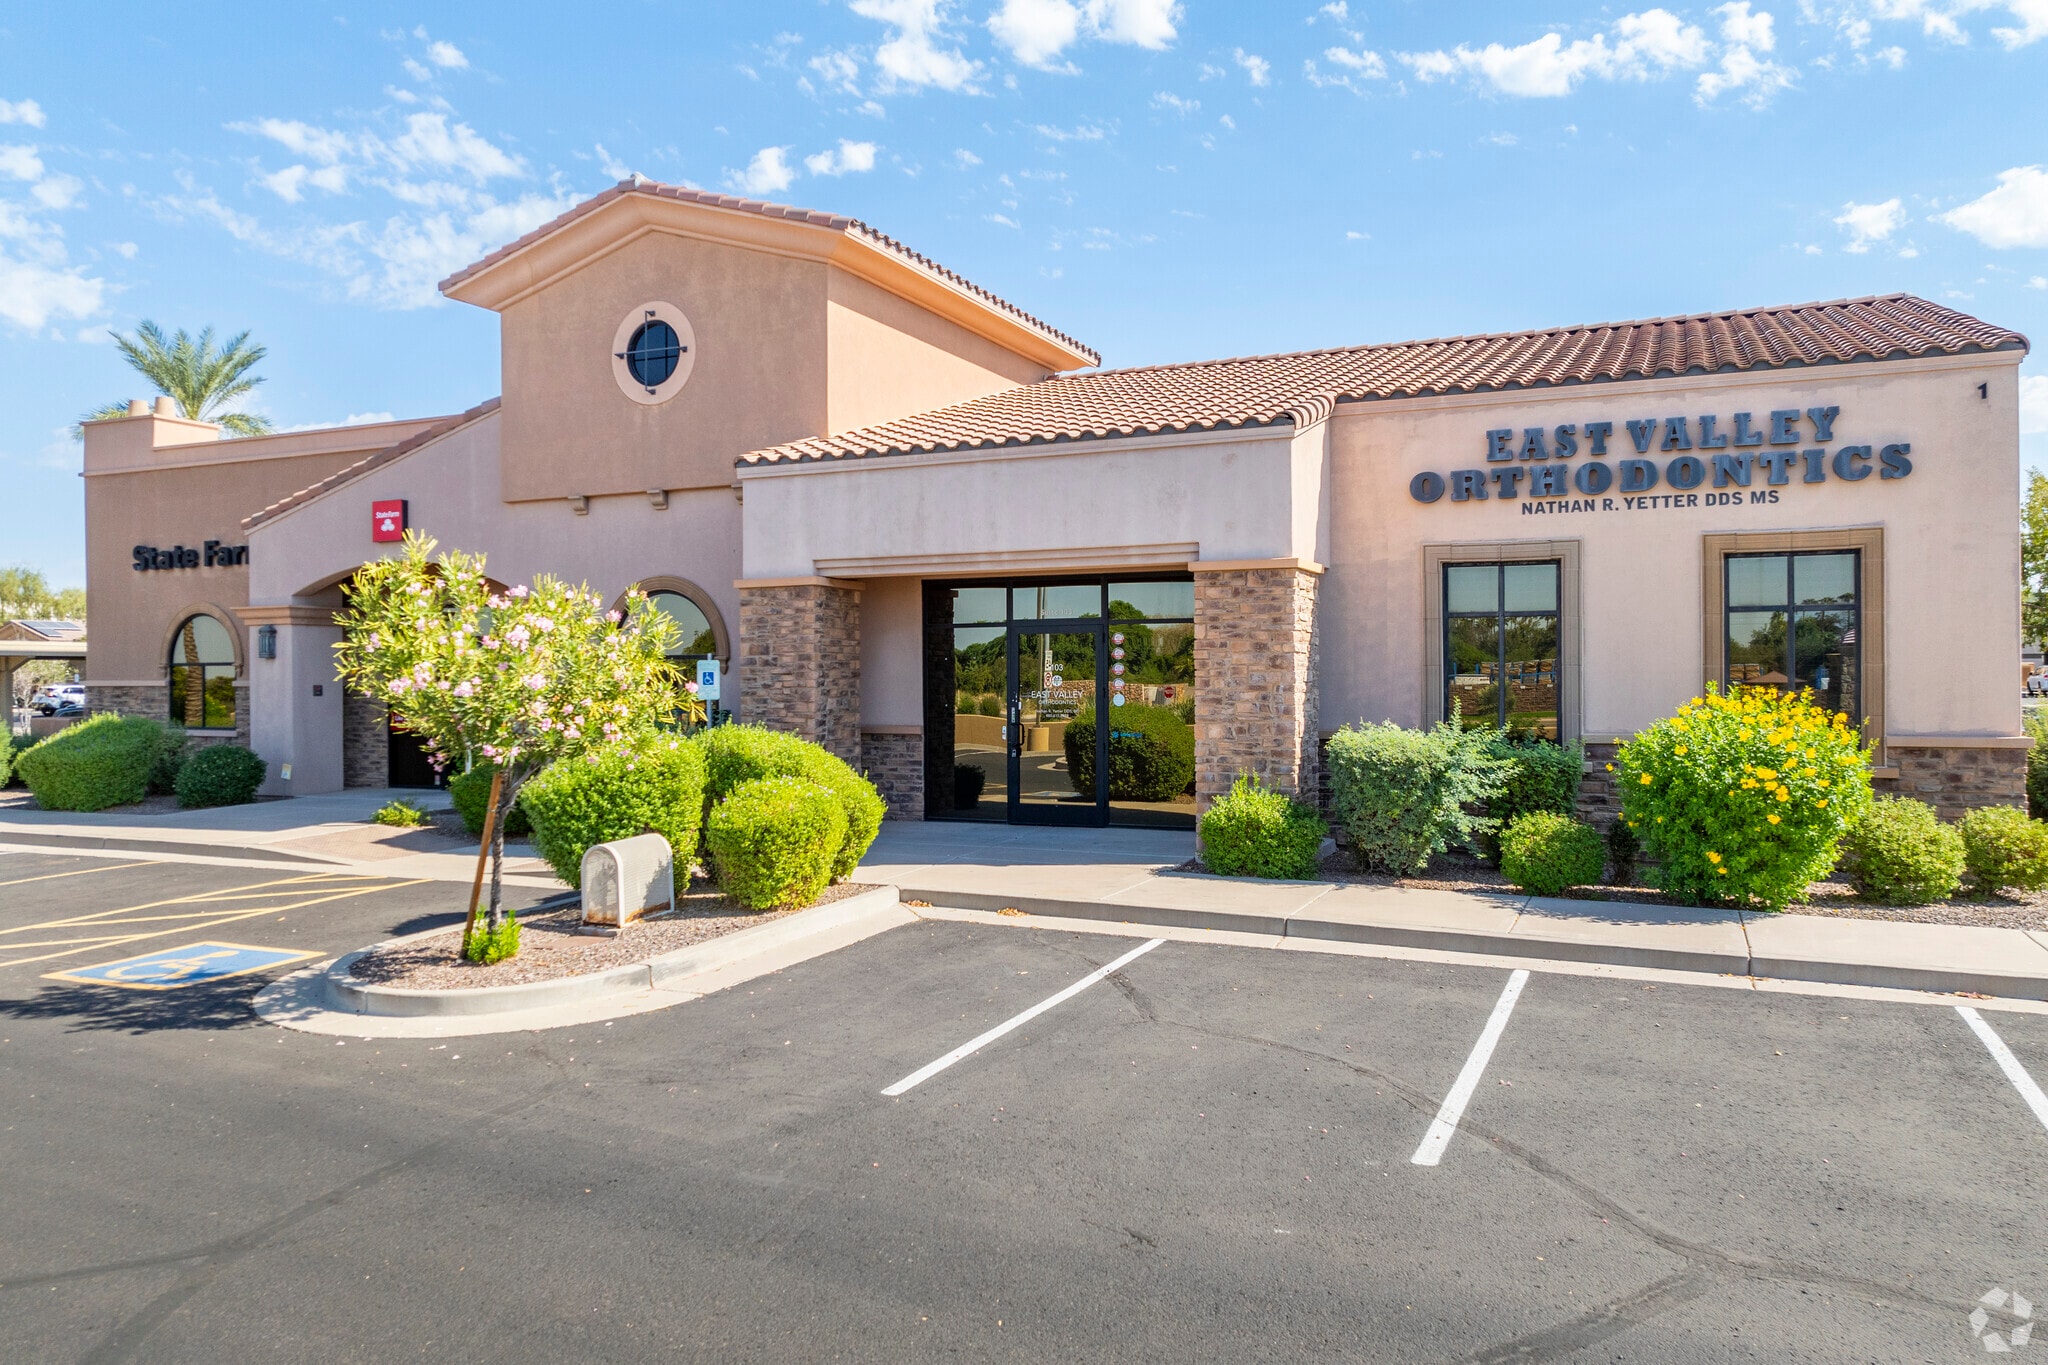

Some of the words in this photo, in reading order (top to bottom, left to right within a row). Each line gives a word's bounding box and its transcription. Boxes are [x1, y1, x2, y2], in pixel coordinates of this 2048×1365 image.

[1486, 421, 1613, 463] EAST
[1626, 406, 1841, 454] VALLEY
[1409, 443, 1913, 504] ORTHODONTICS
[1521, 498, 1596, 516] NATHAN
[1602, 497, 1619, 512] R.
[1623, 493, 1698, 511] YETTER
[1704, 491, 1744, 508] DDS
[1749, 489, 1780, 506] MS
[132, 545, 200, 572] State
[1051, 663, 1064, 671] 103
[1031, 690, 1051, 699] EAST
[1053, 690, 1083, 699] VALLEY
